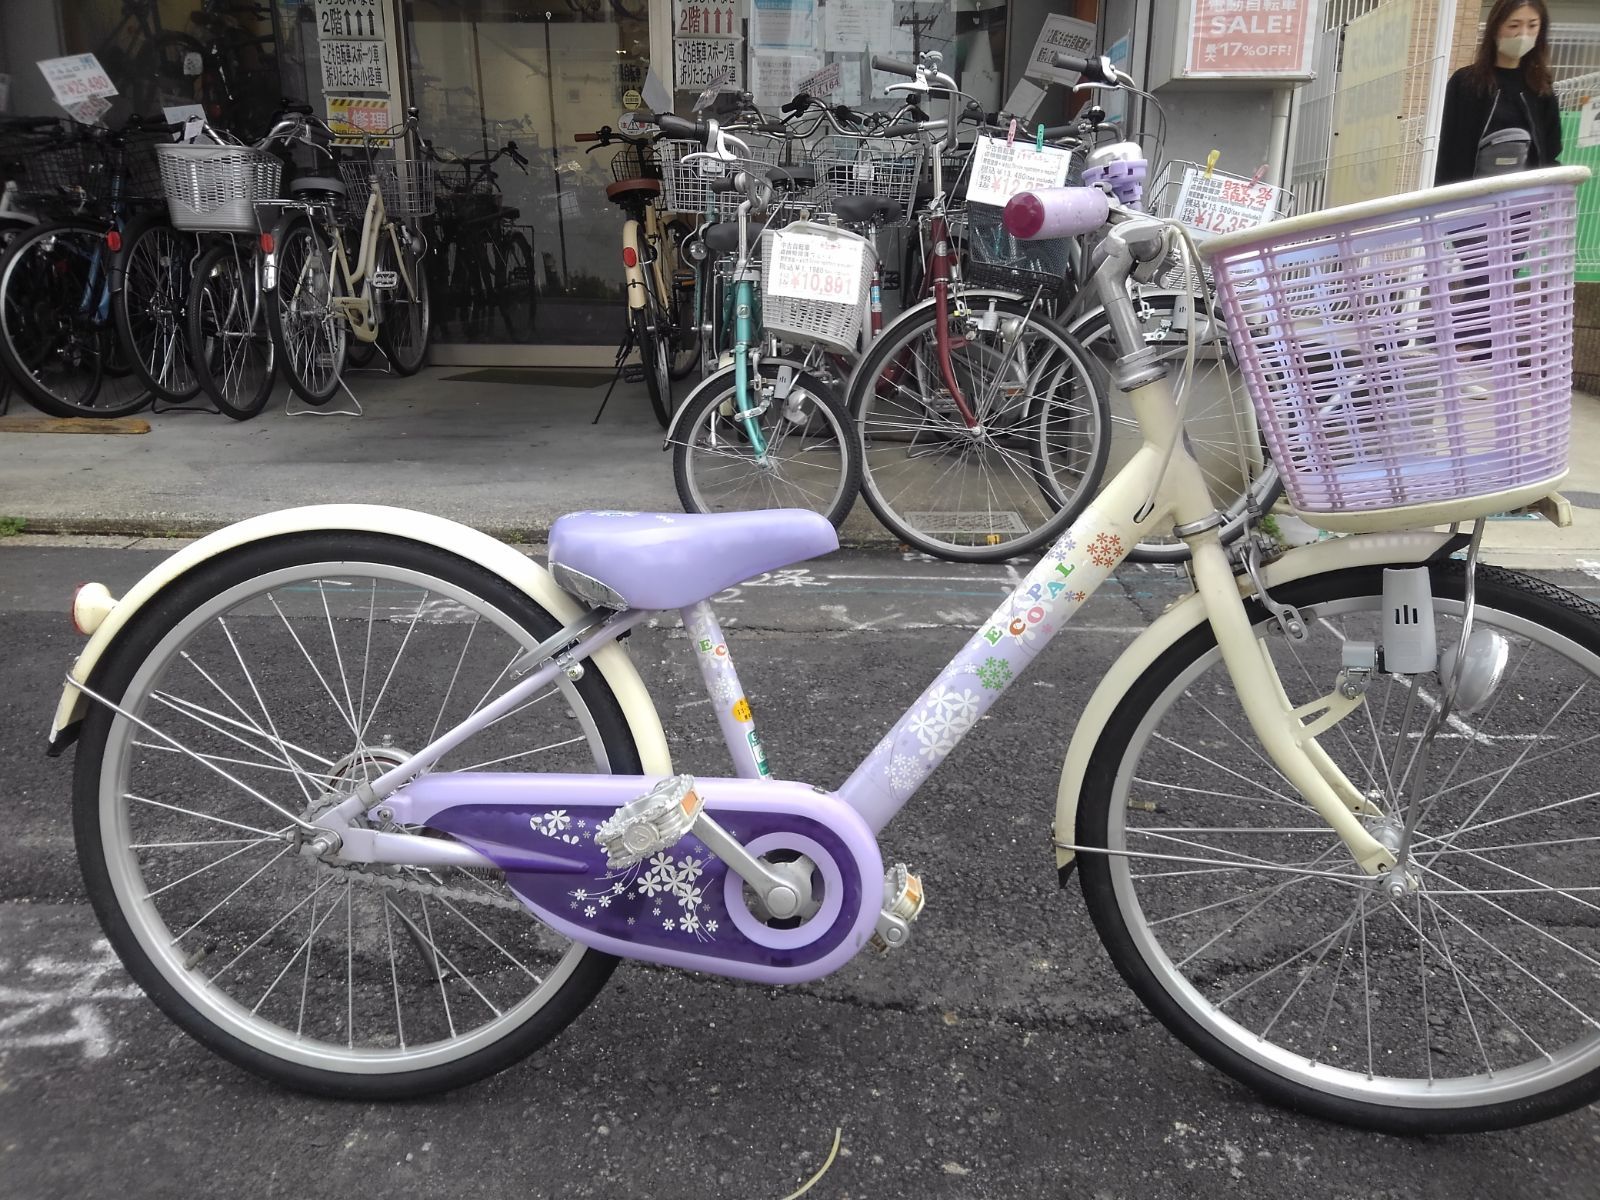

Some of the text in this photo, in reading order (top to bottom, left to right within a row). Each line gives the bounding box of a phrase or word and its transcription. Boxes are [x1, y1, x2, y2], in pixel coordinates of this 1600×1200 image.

[322, 8, 343, 35] 2階
[680, 6, 701, 33] 2階
[1210, 15, 1293, 34] SALE!
[352, 109, 387, 128] 修理
[791, 272, 852, 295] ¥10,891
[983, 562, 1076, 646] ECOPAL
